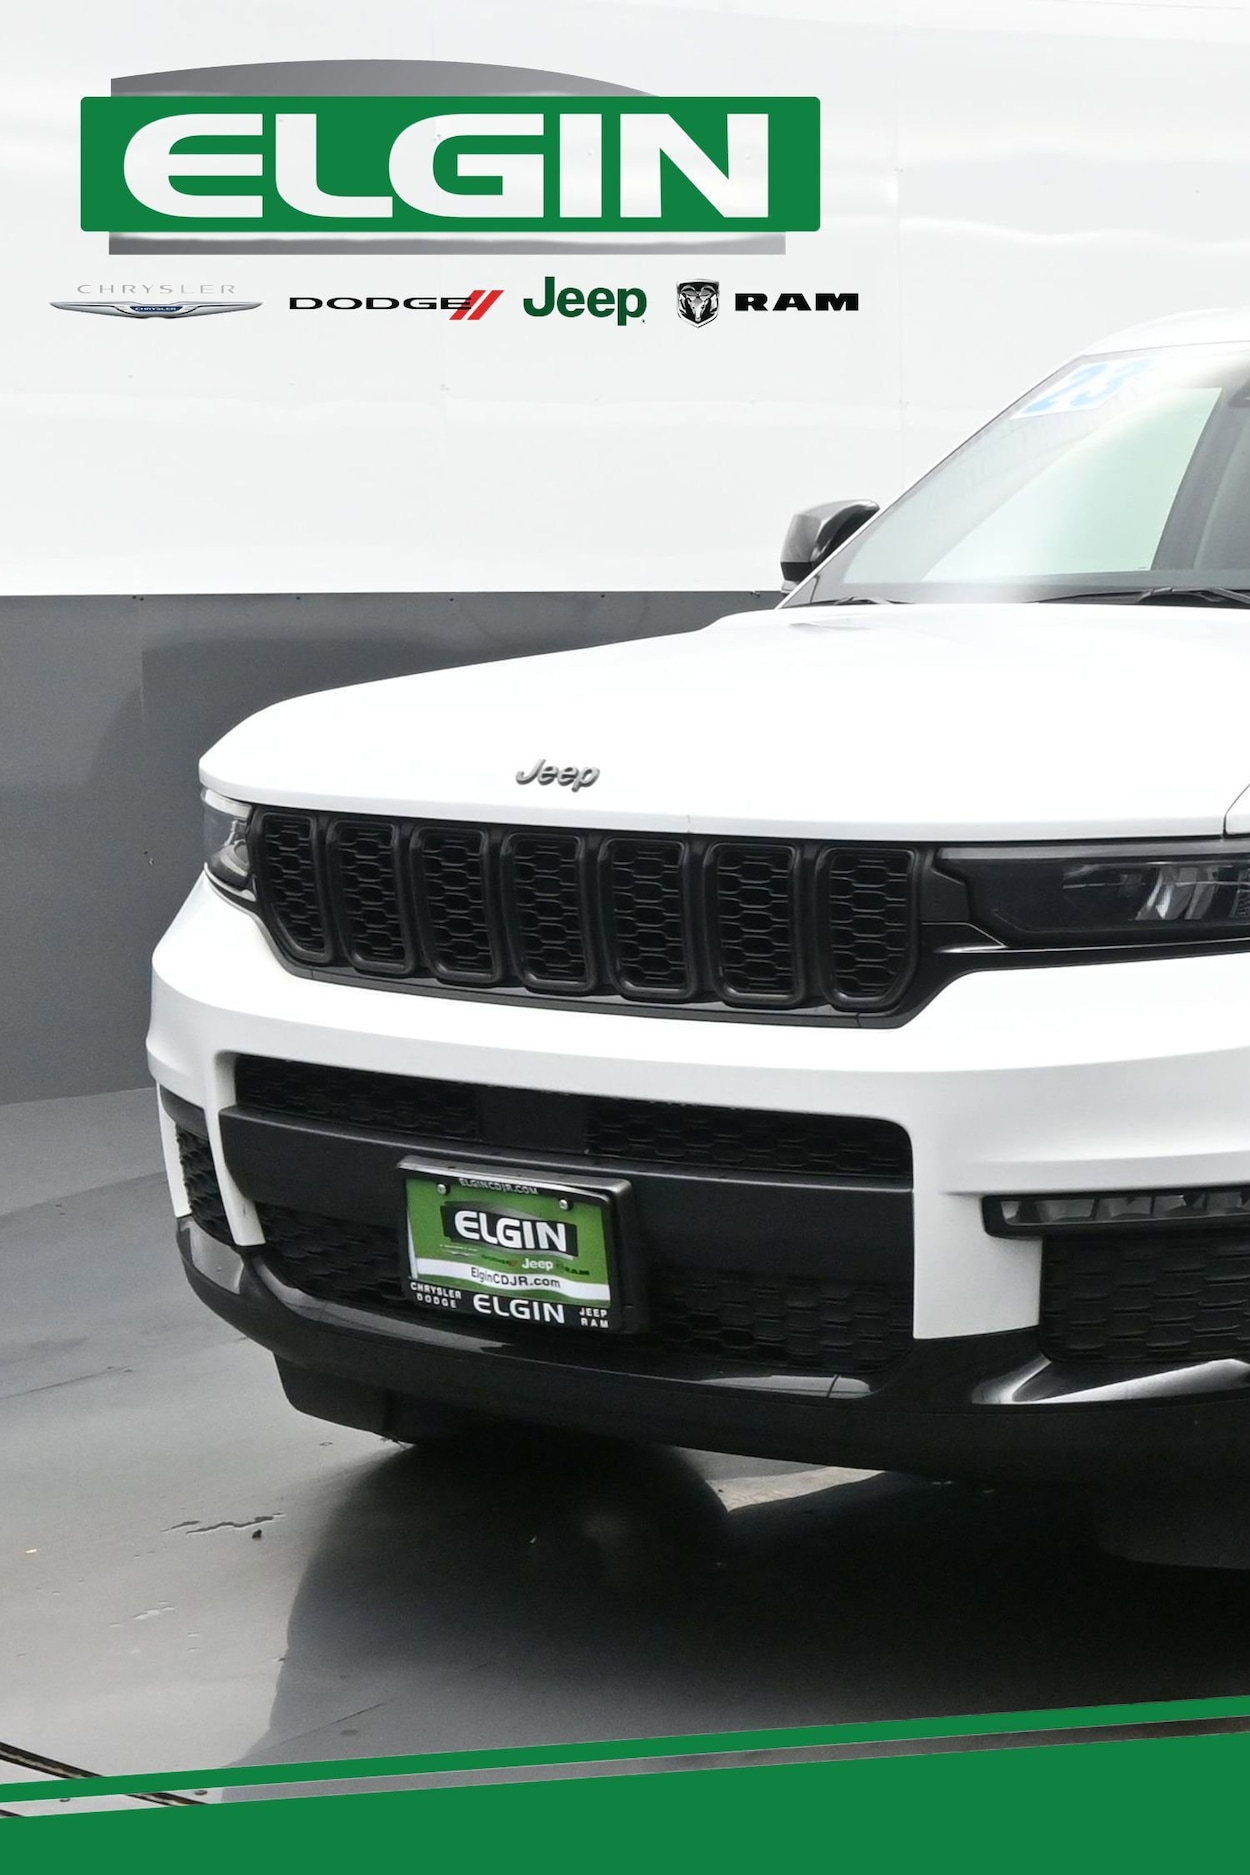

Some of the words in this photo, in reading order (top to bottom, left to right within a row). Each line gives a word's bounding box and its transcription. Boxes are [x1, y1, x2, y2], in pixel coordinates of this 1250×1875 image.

[515, 759, 601, 793] Jeep
[459, 1177, 538, 1196] ELGINCDJR.COM
[454, 1210, 567, 1252] ELGIN
[521, 1258, 554, 1271] Jeep
[470, 1266, 561, 1289] ElginCDJR.com
[410, 1281, 462, 1300] CHRYSLER
[416, 1292, 457, 1309] DODGE
[472, 1293, 565, 1324] ELGIN
[579, 1307, 608, 1318] JEEP
[581, 1317, 609, 1329] RAM
